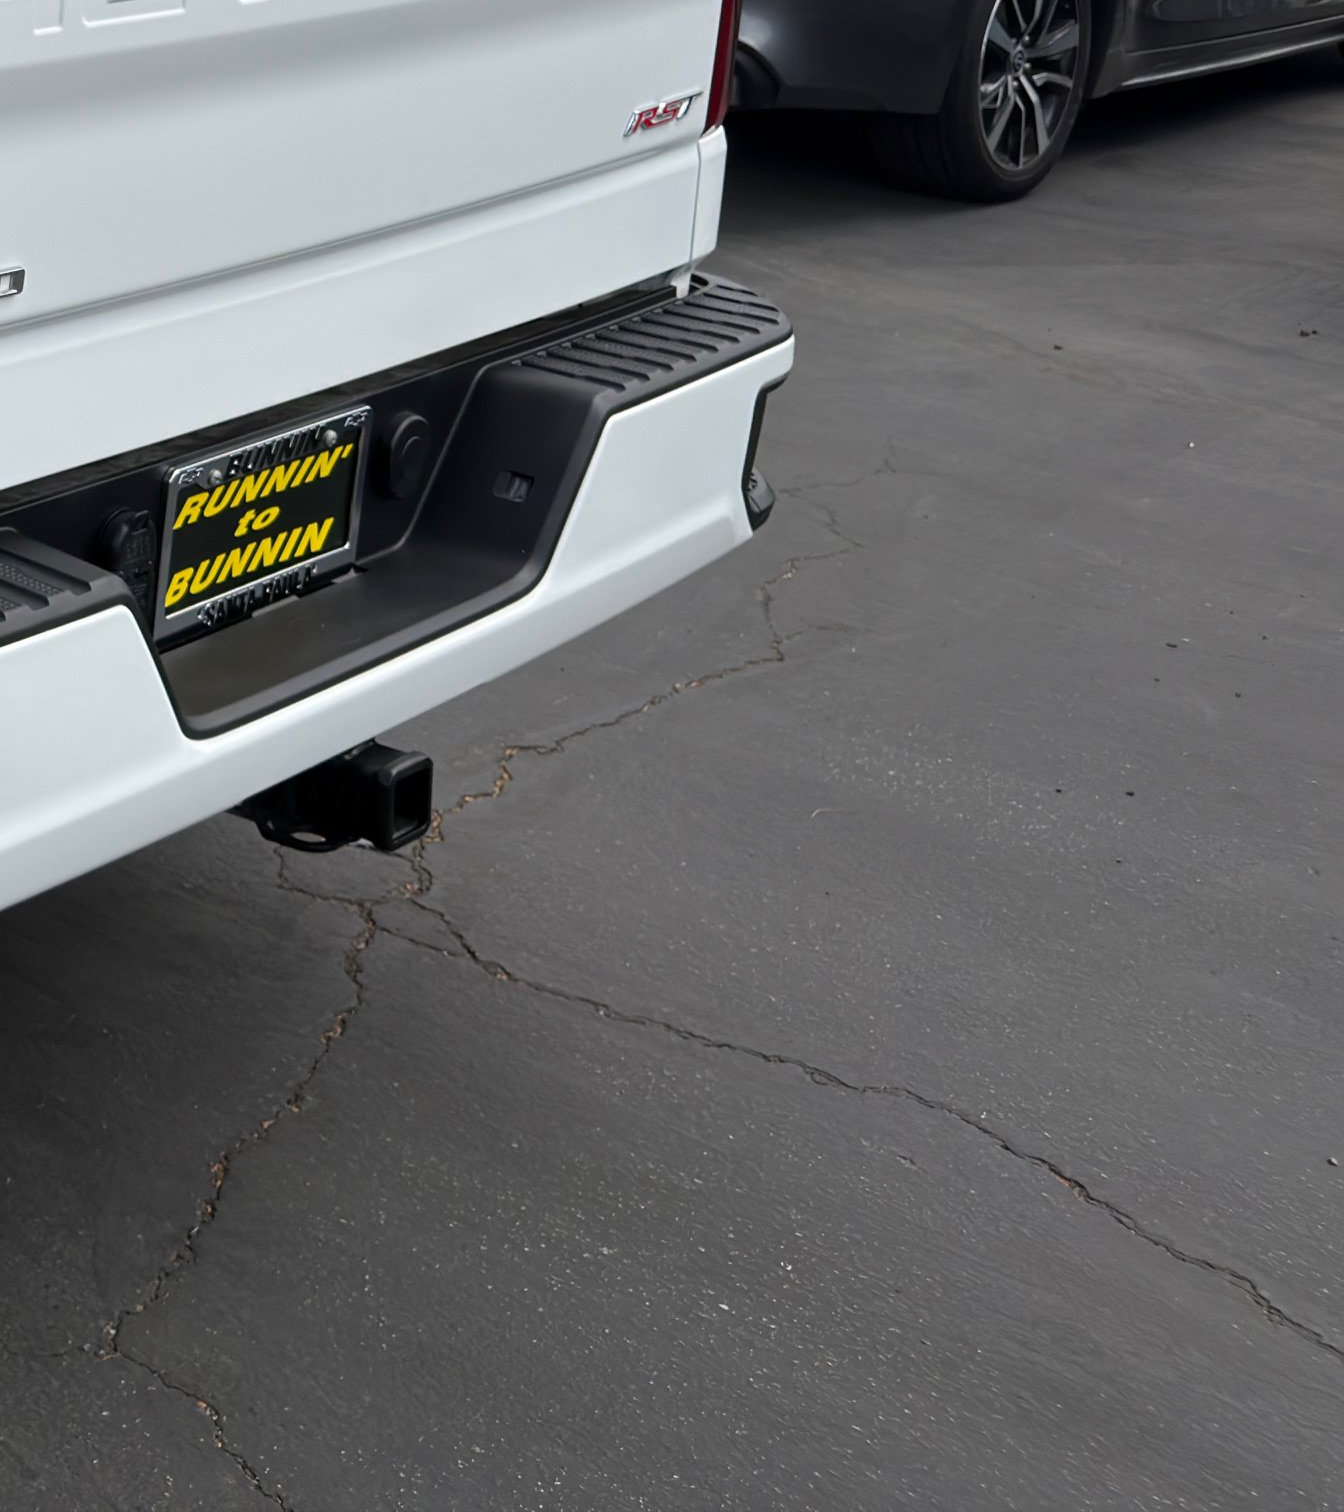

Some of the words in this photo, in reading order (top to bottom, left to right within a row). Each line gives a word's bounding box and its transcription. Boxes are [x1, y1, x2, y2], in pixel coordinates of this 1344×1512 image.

[622, 88, 704, 138] RST
[172, 442, 354, 531] RUNNIN'
[233, 506, 281, 538] to
[163, 517, 335, 608] BUNNIN
